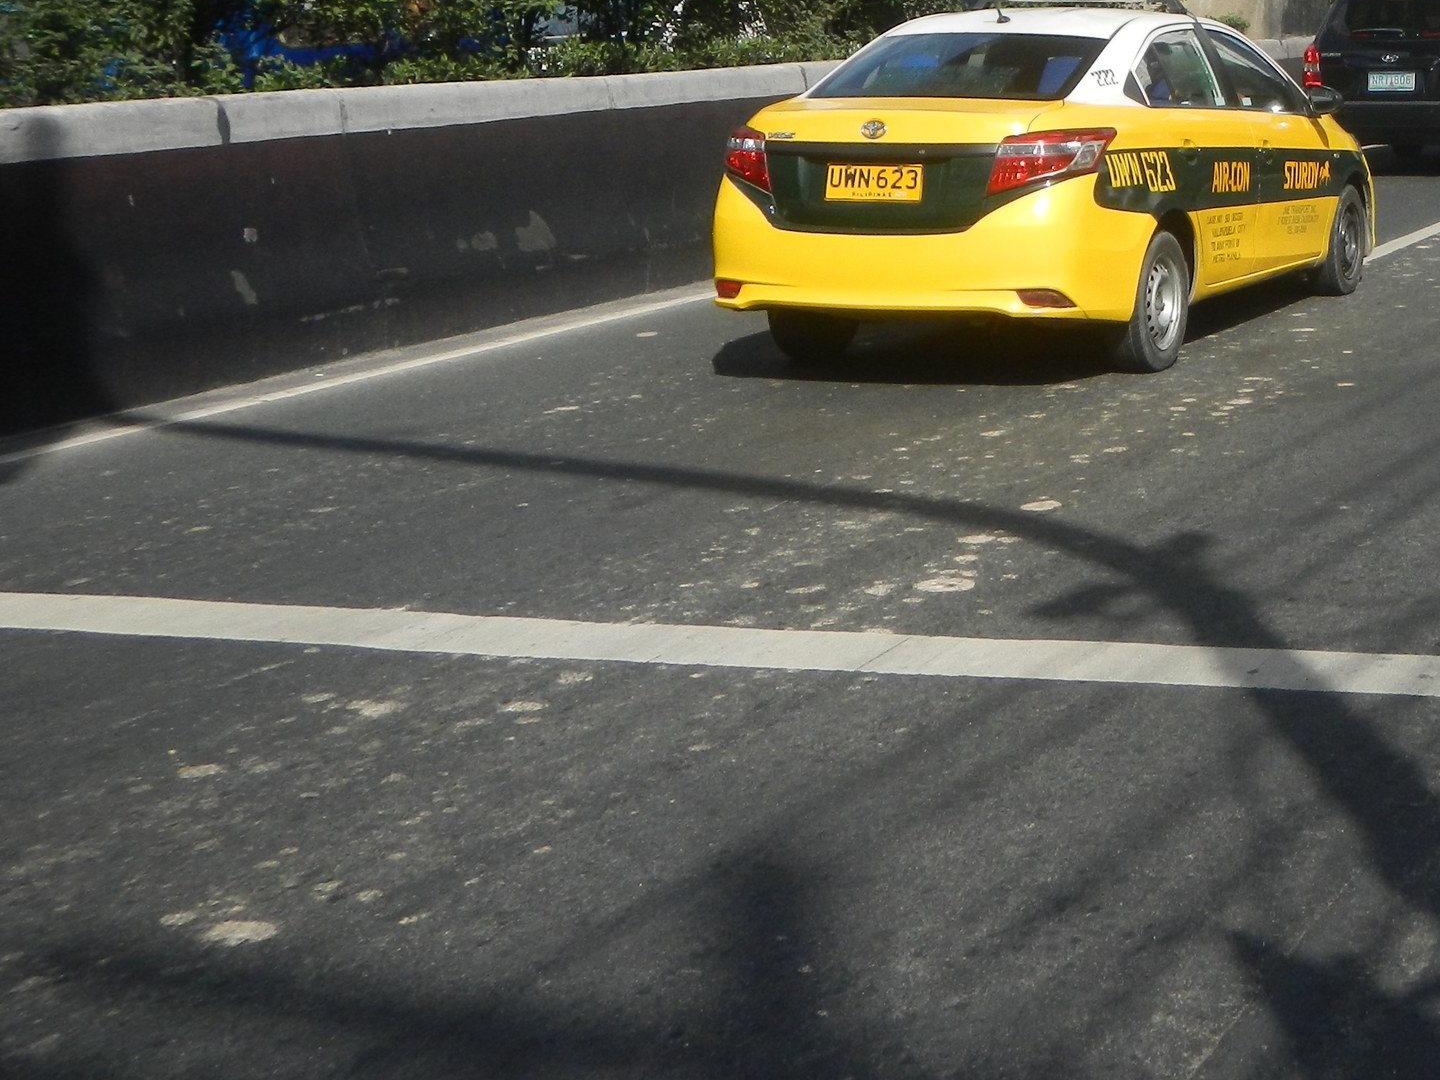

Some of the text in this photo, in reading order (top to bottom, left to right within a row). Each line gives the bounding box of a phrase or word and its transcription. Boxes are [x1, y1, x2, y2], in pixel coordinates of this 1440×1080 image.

[1140, 151, 1177, 193] 623
[1212, 161, 1251, 193] AIR-CON
[1283, 160, 1320, 190] STURDY
